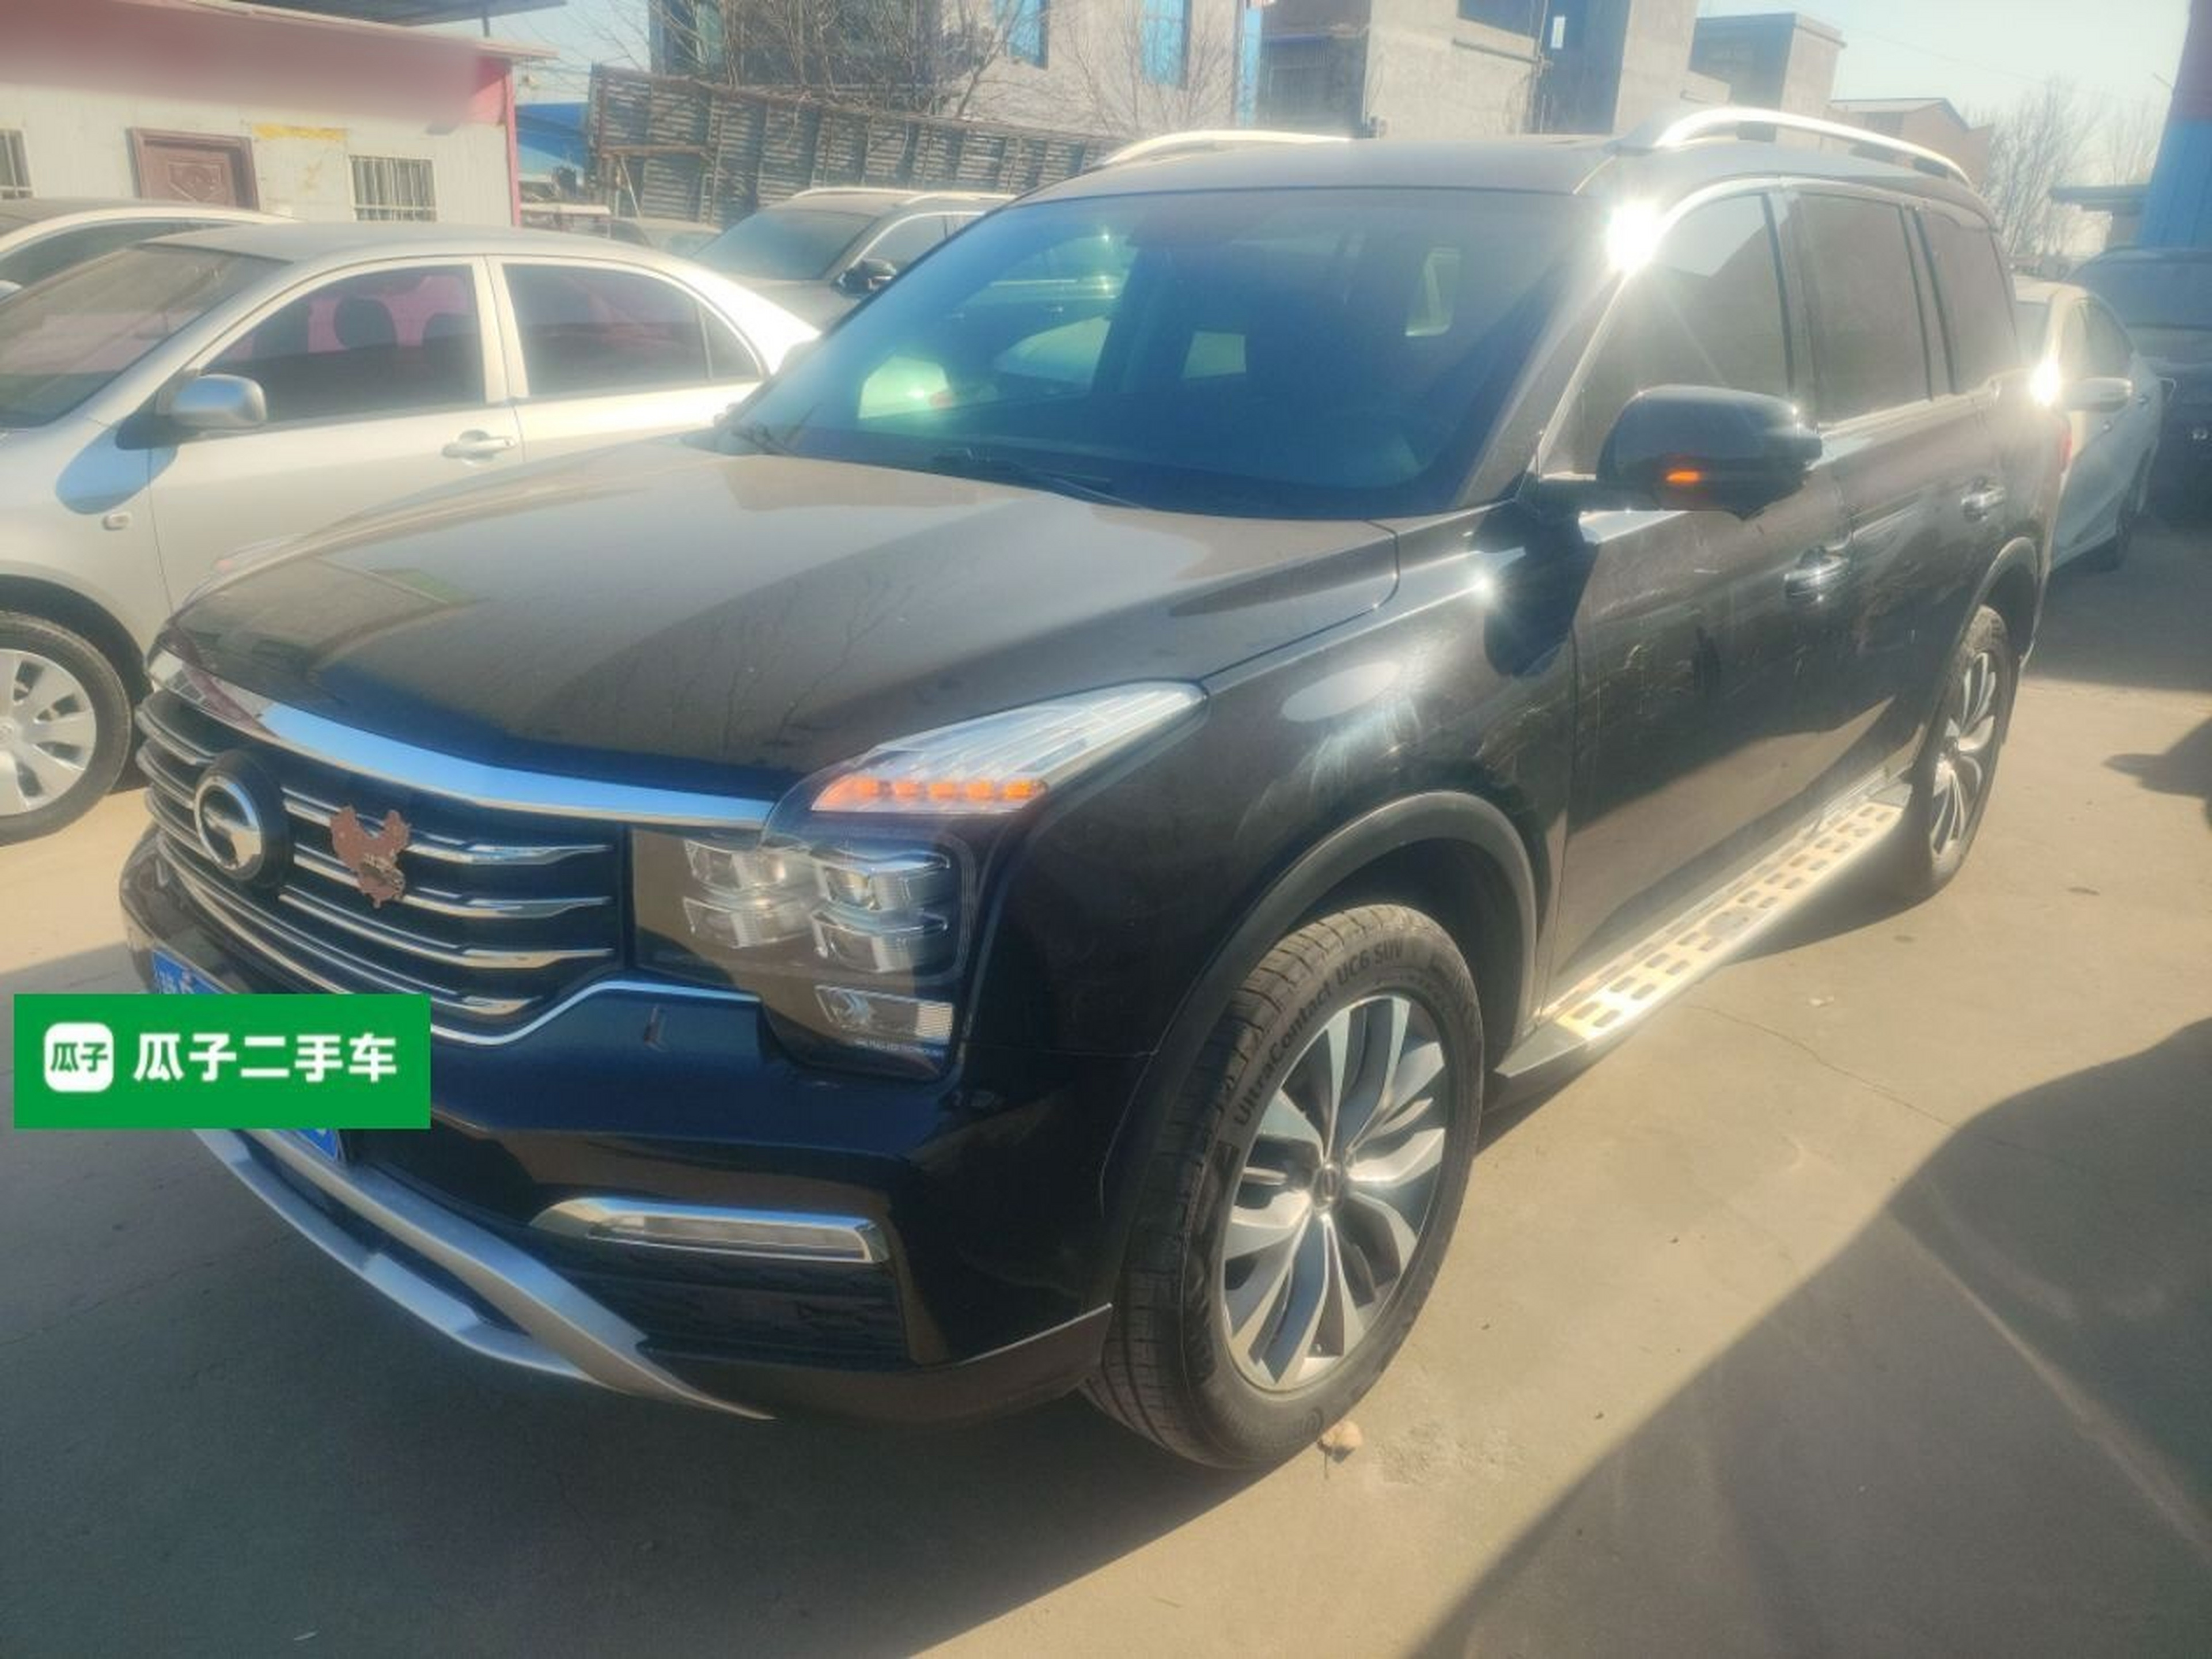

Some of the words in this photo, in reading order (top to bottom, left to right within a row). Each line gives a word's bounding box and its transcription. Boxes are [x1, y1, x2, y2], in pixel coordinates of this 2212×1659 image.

[1234, 980, 1333, 1124] UltraContact
[1335, 949, 1370, 985] UC6
[1374, 937, 1403, 964] SUV
